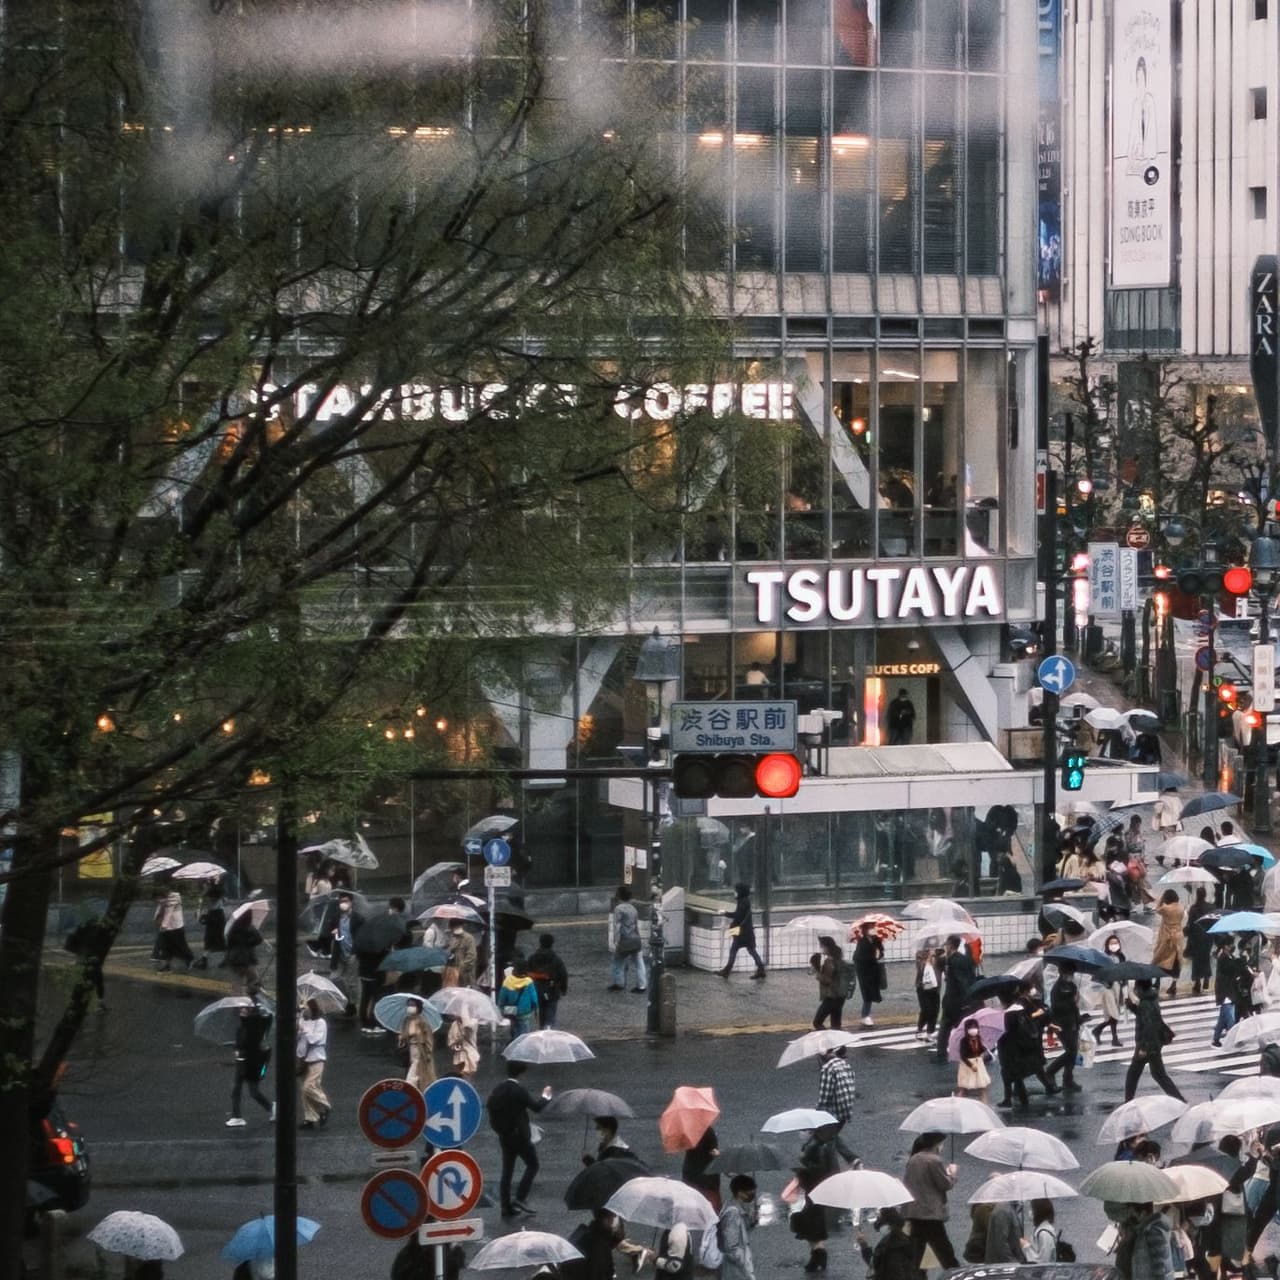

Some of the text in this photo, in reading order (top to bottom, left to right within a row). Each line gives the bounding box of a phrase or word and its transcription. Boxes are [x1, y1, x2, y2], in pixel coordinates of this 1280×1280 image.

[1255, 272, 1274, 356] ZARA
[747, 565, 1003, 625] TSUTAYA
[1101, 548, 1115, 609] 渋谷駅前
[680, 706, 787, 731] 渋谷駅前
[695, 733, 775, 747] Shibuya Sta.
